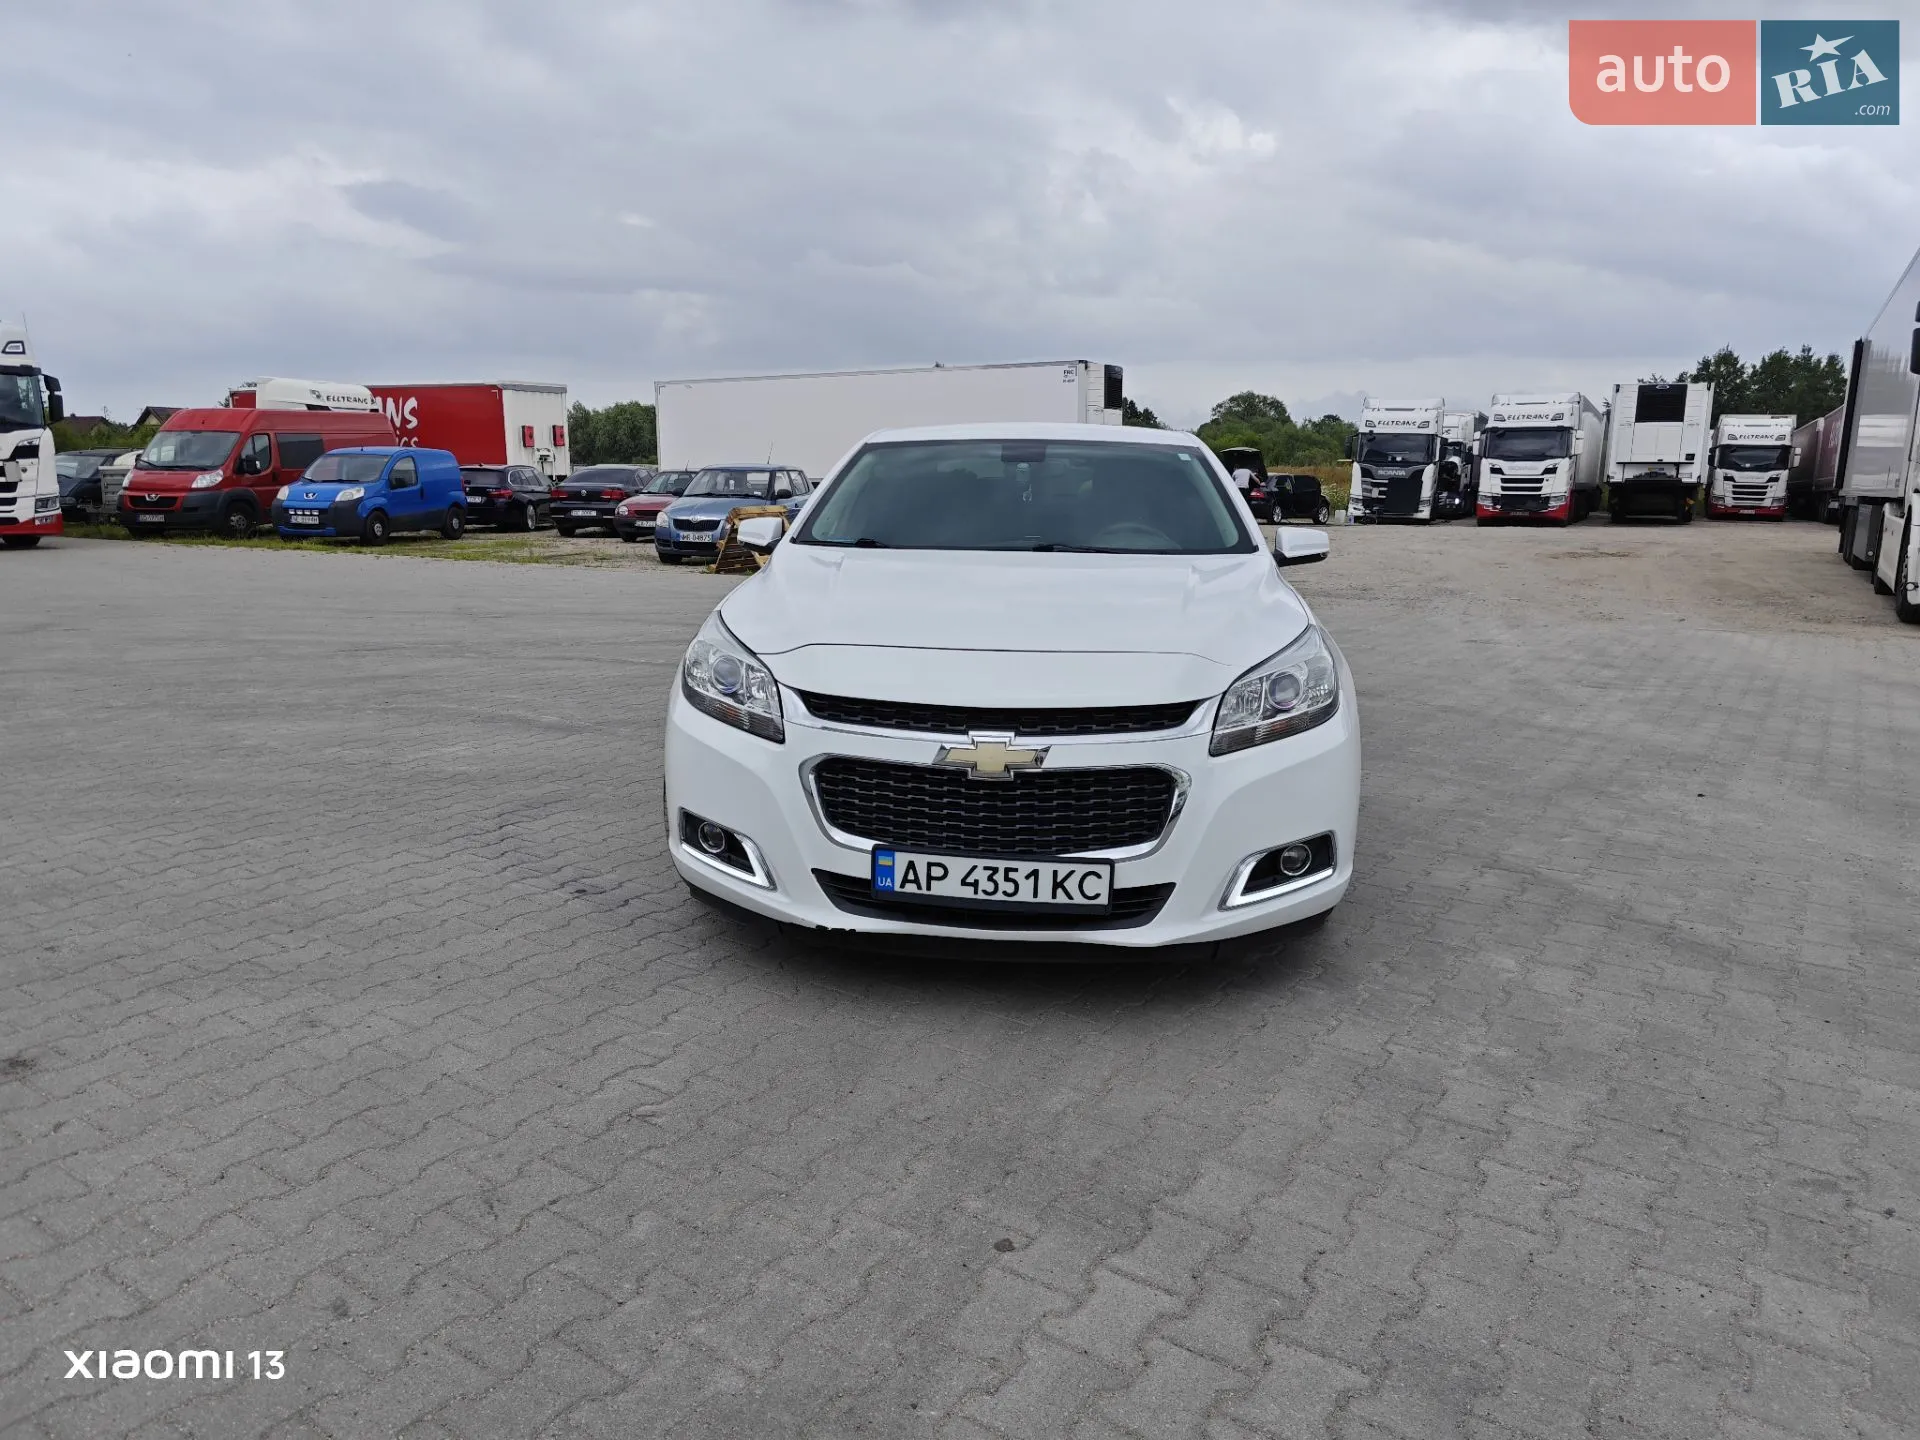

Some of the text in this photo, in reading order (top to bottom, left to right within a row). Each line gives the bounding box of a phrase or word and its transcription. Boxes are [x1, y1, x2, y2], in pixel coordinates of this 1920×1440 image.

[878, 876, 893, 888] UA
[899, 860, 1103, 901] AP 4351 KC
